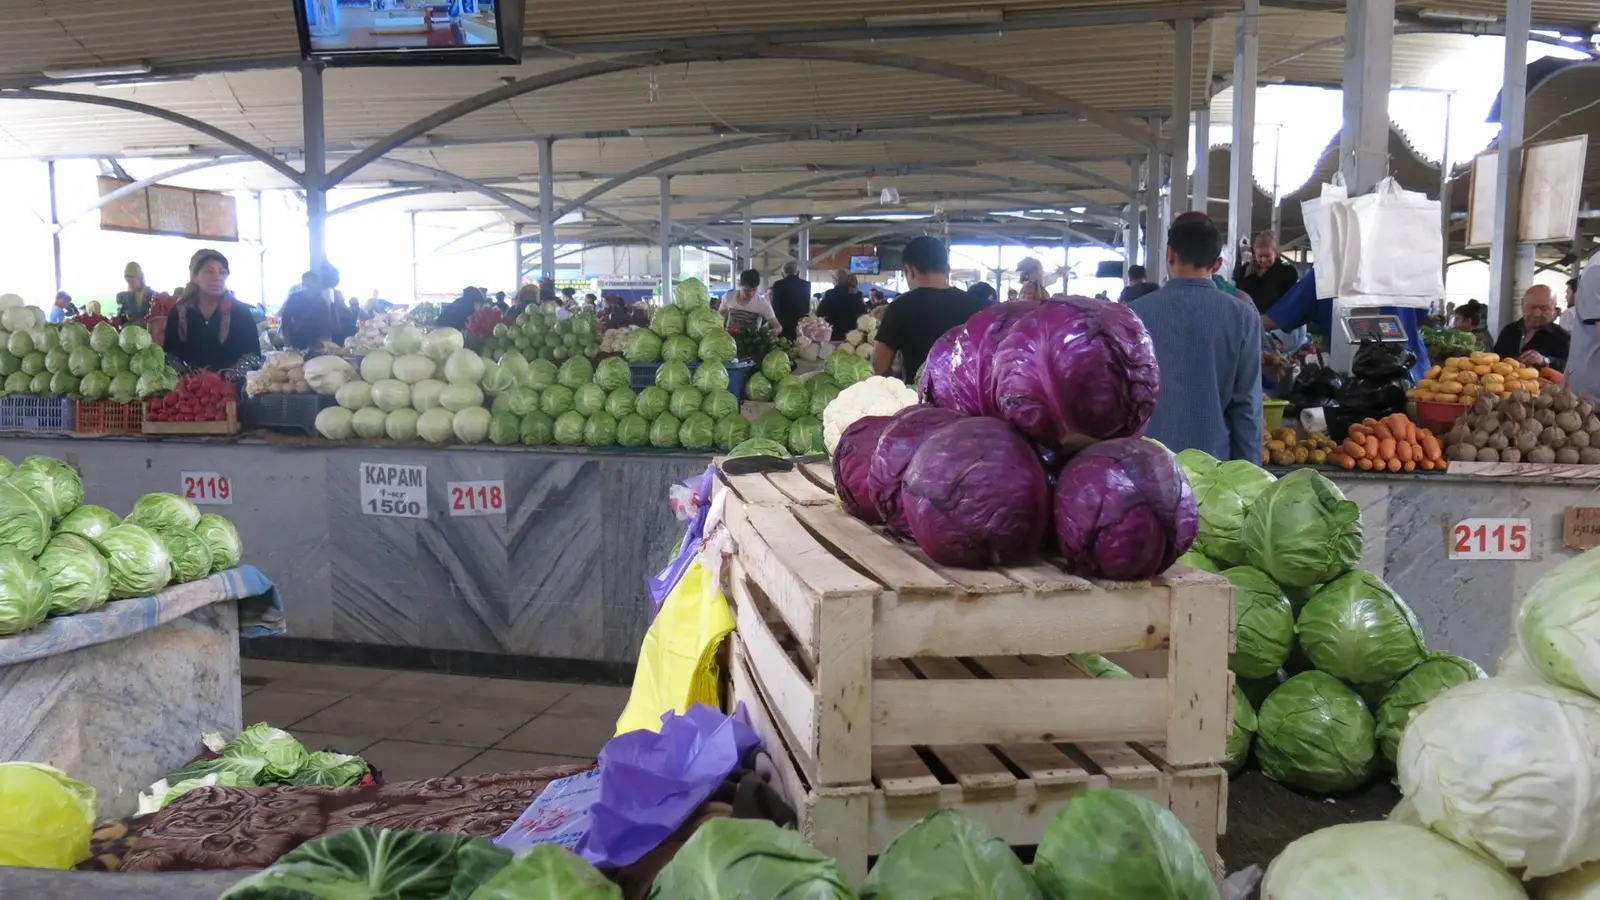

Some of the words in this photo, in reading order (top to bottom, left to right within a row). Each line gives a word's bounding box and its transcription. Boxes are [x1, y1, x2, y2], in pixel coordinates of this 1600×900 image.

[184, 475, 230, 500] 2119
[366, 465, 422, 488] КАРАМ
[367, 498, 421, 515] 1500
[451, 486, 503, 511] 2118
[1454, 524, 1527, 552] 2115
